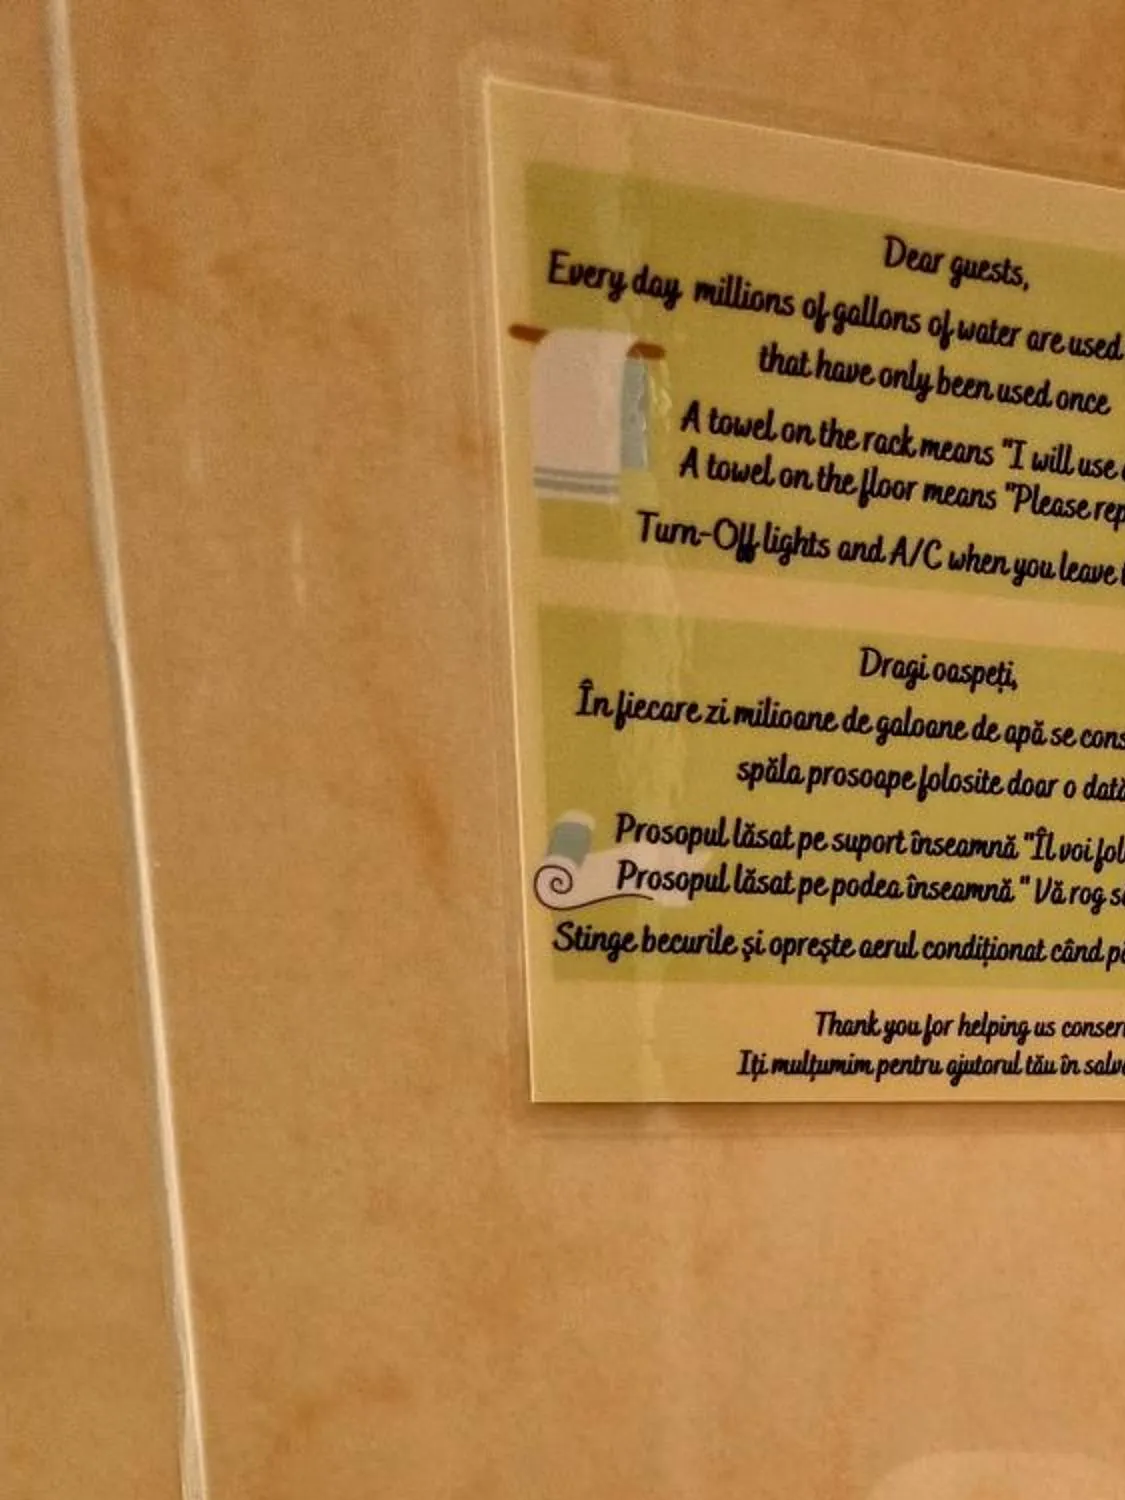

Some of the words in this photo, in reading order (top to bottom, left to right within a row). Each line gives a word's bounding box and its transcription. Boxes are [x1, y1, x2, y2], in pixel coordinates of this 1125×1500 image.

[883, 235, 944, 273] Dear
[950, 254, 1029, 290] guests,
[548, 249, 627, 301] Every
[632, 265, 682, 310] day
[694, 275, 795, 317] millions
[803, 292, 831, 332] of
[834, 295, 920, 334] gallons
[928, 309, 957, 350] of
[959, 318, 1022, 347] water
[1027, 329, 1065, 353] are
[1069, 332, 1124, 361] used
[759, 342, 812, 376] that
[816, 348, 876, 384] have
[880, 360, 934, 401] only
[937, 365, 993, 400] been
[998, 380, 1052, 408] used
[1056, 389, 1111, 416] once
[680, 400, 700, 433] A
[708, 408, 777, 441] towel
[781, 421, 815, 446] on
[819, 417, 860, 450] the
[863, 424, 917, 458] rack
[921, 436, 994, 466] means
[1002, 437, 1027, 470] "I
[1032, 444, 1074, 477] will
[1078, 456, 1118, 479] use
[679, 446, 699, 478] A
[707, 453, 775, 486] towel
[779, 466, 813, 490] on
[817, 462, 858, 495] the
[857, 466, 917, 508] floor
[923, 480, 996, 511] means
[1005, 481, 1091, 520] "Please
[636, 510, 760, 563] Turn-Off
[763, 521, 830, 566] lights
[837, 534, 886, 563] and
[889, 536, 942, 570] A/C
[948, 542, 1010, 575] when
[1013, 559, 1056, 587] you
[1059, 550, 1118, 584] leave
[859, 646, 930, 690] Dragi
[575, 678, 613, 718] În
[613, 689, 702, 731] fiecare
[705, 698, 730, 725] zi
[733, 696, 839, 732] milioane
[842, 705, 873, 735] de
[876, 705, 969, 746] galoane
[972, 714, 1000, 743] de
[1004, 719, 1048, 752] apă
[1051, 726, 1076, 748] se
[736, 753, 805, 791] spăla
[806, 766, 917, 798] prosoape
[915, 763, 1004, 802] folosite
[1007, 768, 1059, 799] doar
[1063, 780, 1076, 798] o
[616, 812, 729, 854] Prosopul
[733, 816, 795, 850] lăsat
[796, 829, 829, 859] pe
[831, 829, 908, 862] suport
[910, 829, 1019, 860] înseamnă
[1059, 837, 1092, 862] voi
[617, 859, 730, 900] Prosopul
[734, 862, 796, 895] lăsat
[797, 874, 829, 904] pe
[830, 869, 905, 905] podea
[906, 875, 1015, 901] înseamnă
[1069, 885, 1107, 915] rog
[552, 920, 639, 963] Stinge
[641, 924, 738, 954] becurile
[858, 929, 919, 960] aerul
[1050, 936, 1105, 963] când
[815, 1009, 883, 1037] Thank
[883, 1018, 923, 1045] you
[922, 1013, 955, 1046] for
[957, 1010, 1031, 1045] helping
[1034, 1019, 1056, 1038] us
[876, 1055, 943, 1082] pentru
[946, 1050, 1022, 1086] ajutorul
[1025, 1053, 1058, 1076] tău
[1060, 1053, 1082, 1076] în
